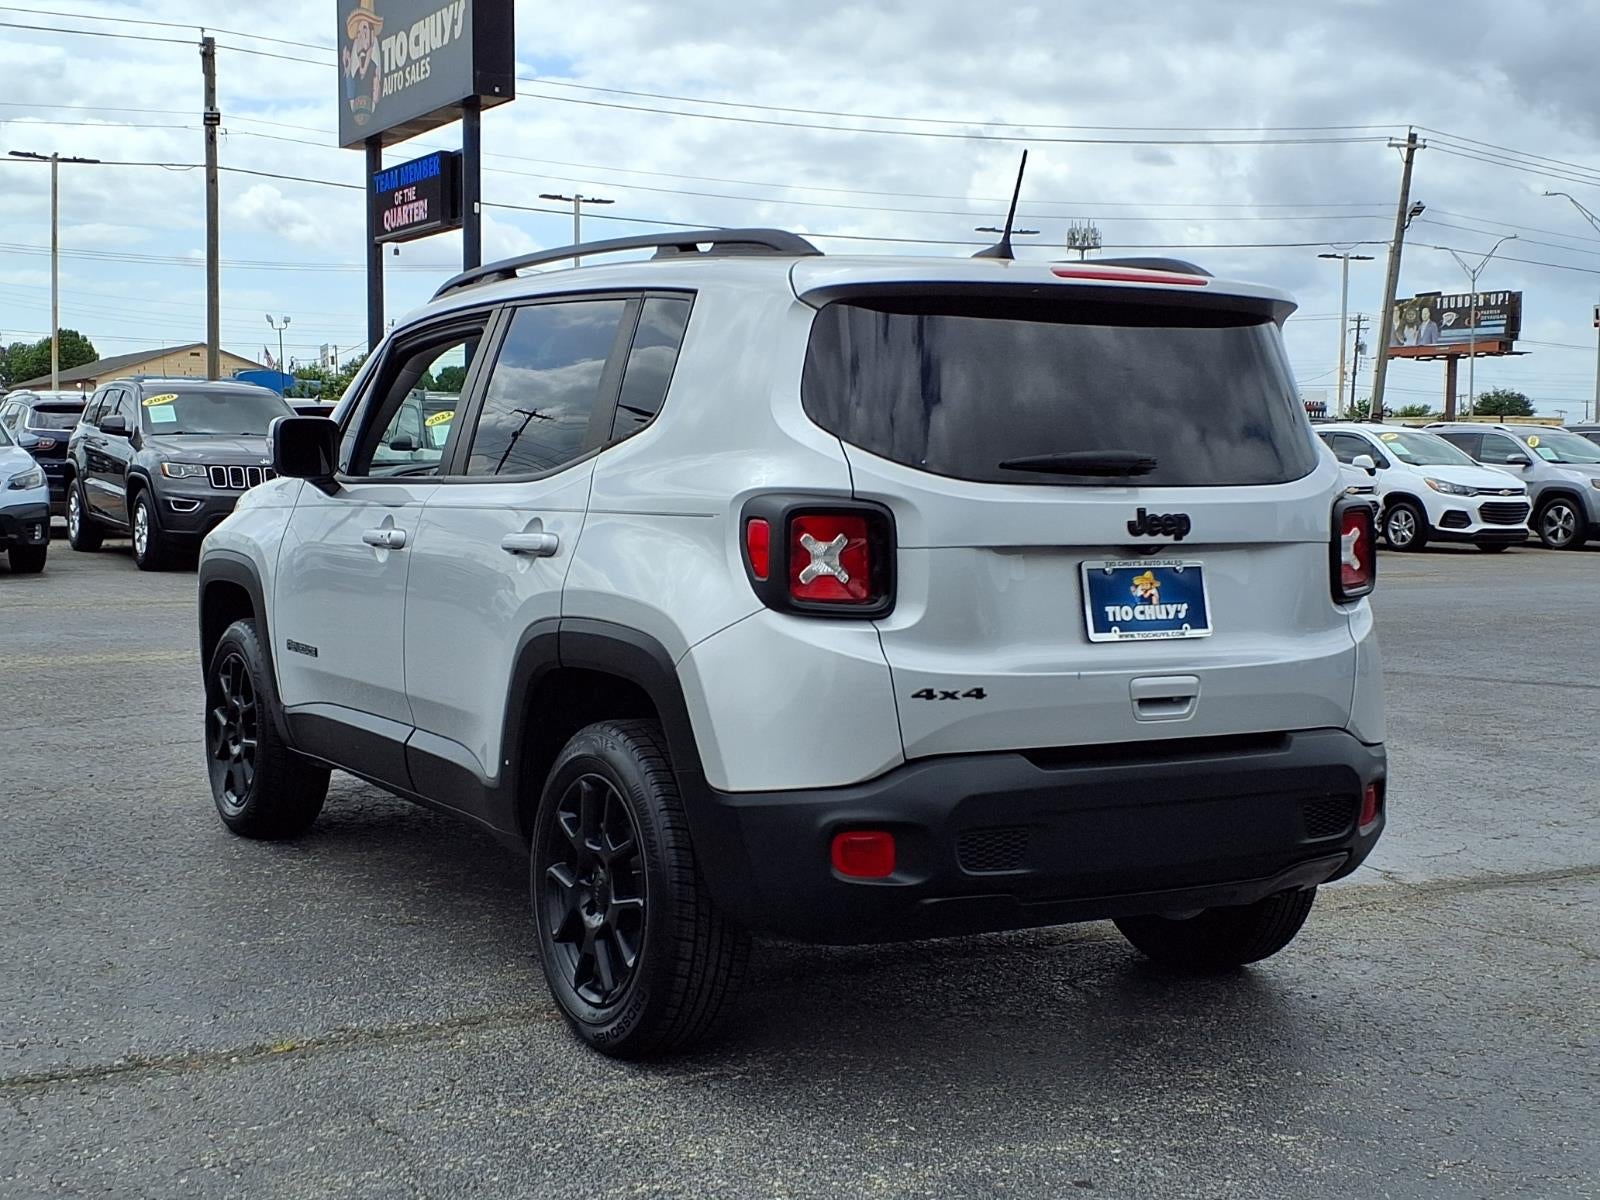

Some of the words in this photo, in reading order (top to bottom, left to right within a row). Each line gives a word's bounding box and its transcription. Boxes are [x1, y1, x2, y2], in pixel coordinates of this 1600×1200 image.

[382, 31, 407, 73] TIO
[409, 0, 466, 61] CHUY'S
[383, 72, 404, 97] AUTO
[405, 57, 431, 88] SALES
[375, 169, 398, 193] TEAM
[401, 155, 440, 186] MEMBER
[394, 191, 403, 205] OF
[403, 186, 416, 203] THE
[383, 199, 428, 232] QUARTER!
[1436, 294, 1484, 309] THUNDER
[1490, 292, 1509, 305] UP!
[1127, 507, 1191, 541] Jeep
[1104, 606, 1133, 622] TIO
[1134, 603, 1188, 621] CHUY'S
[911, 687, 988, 701] 4x4
